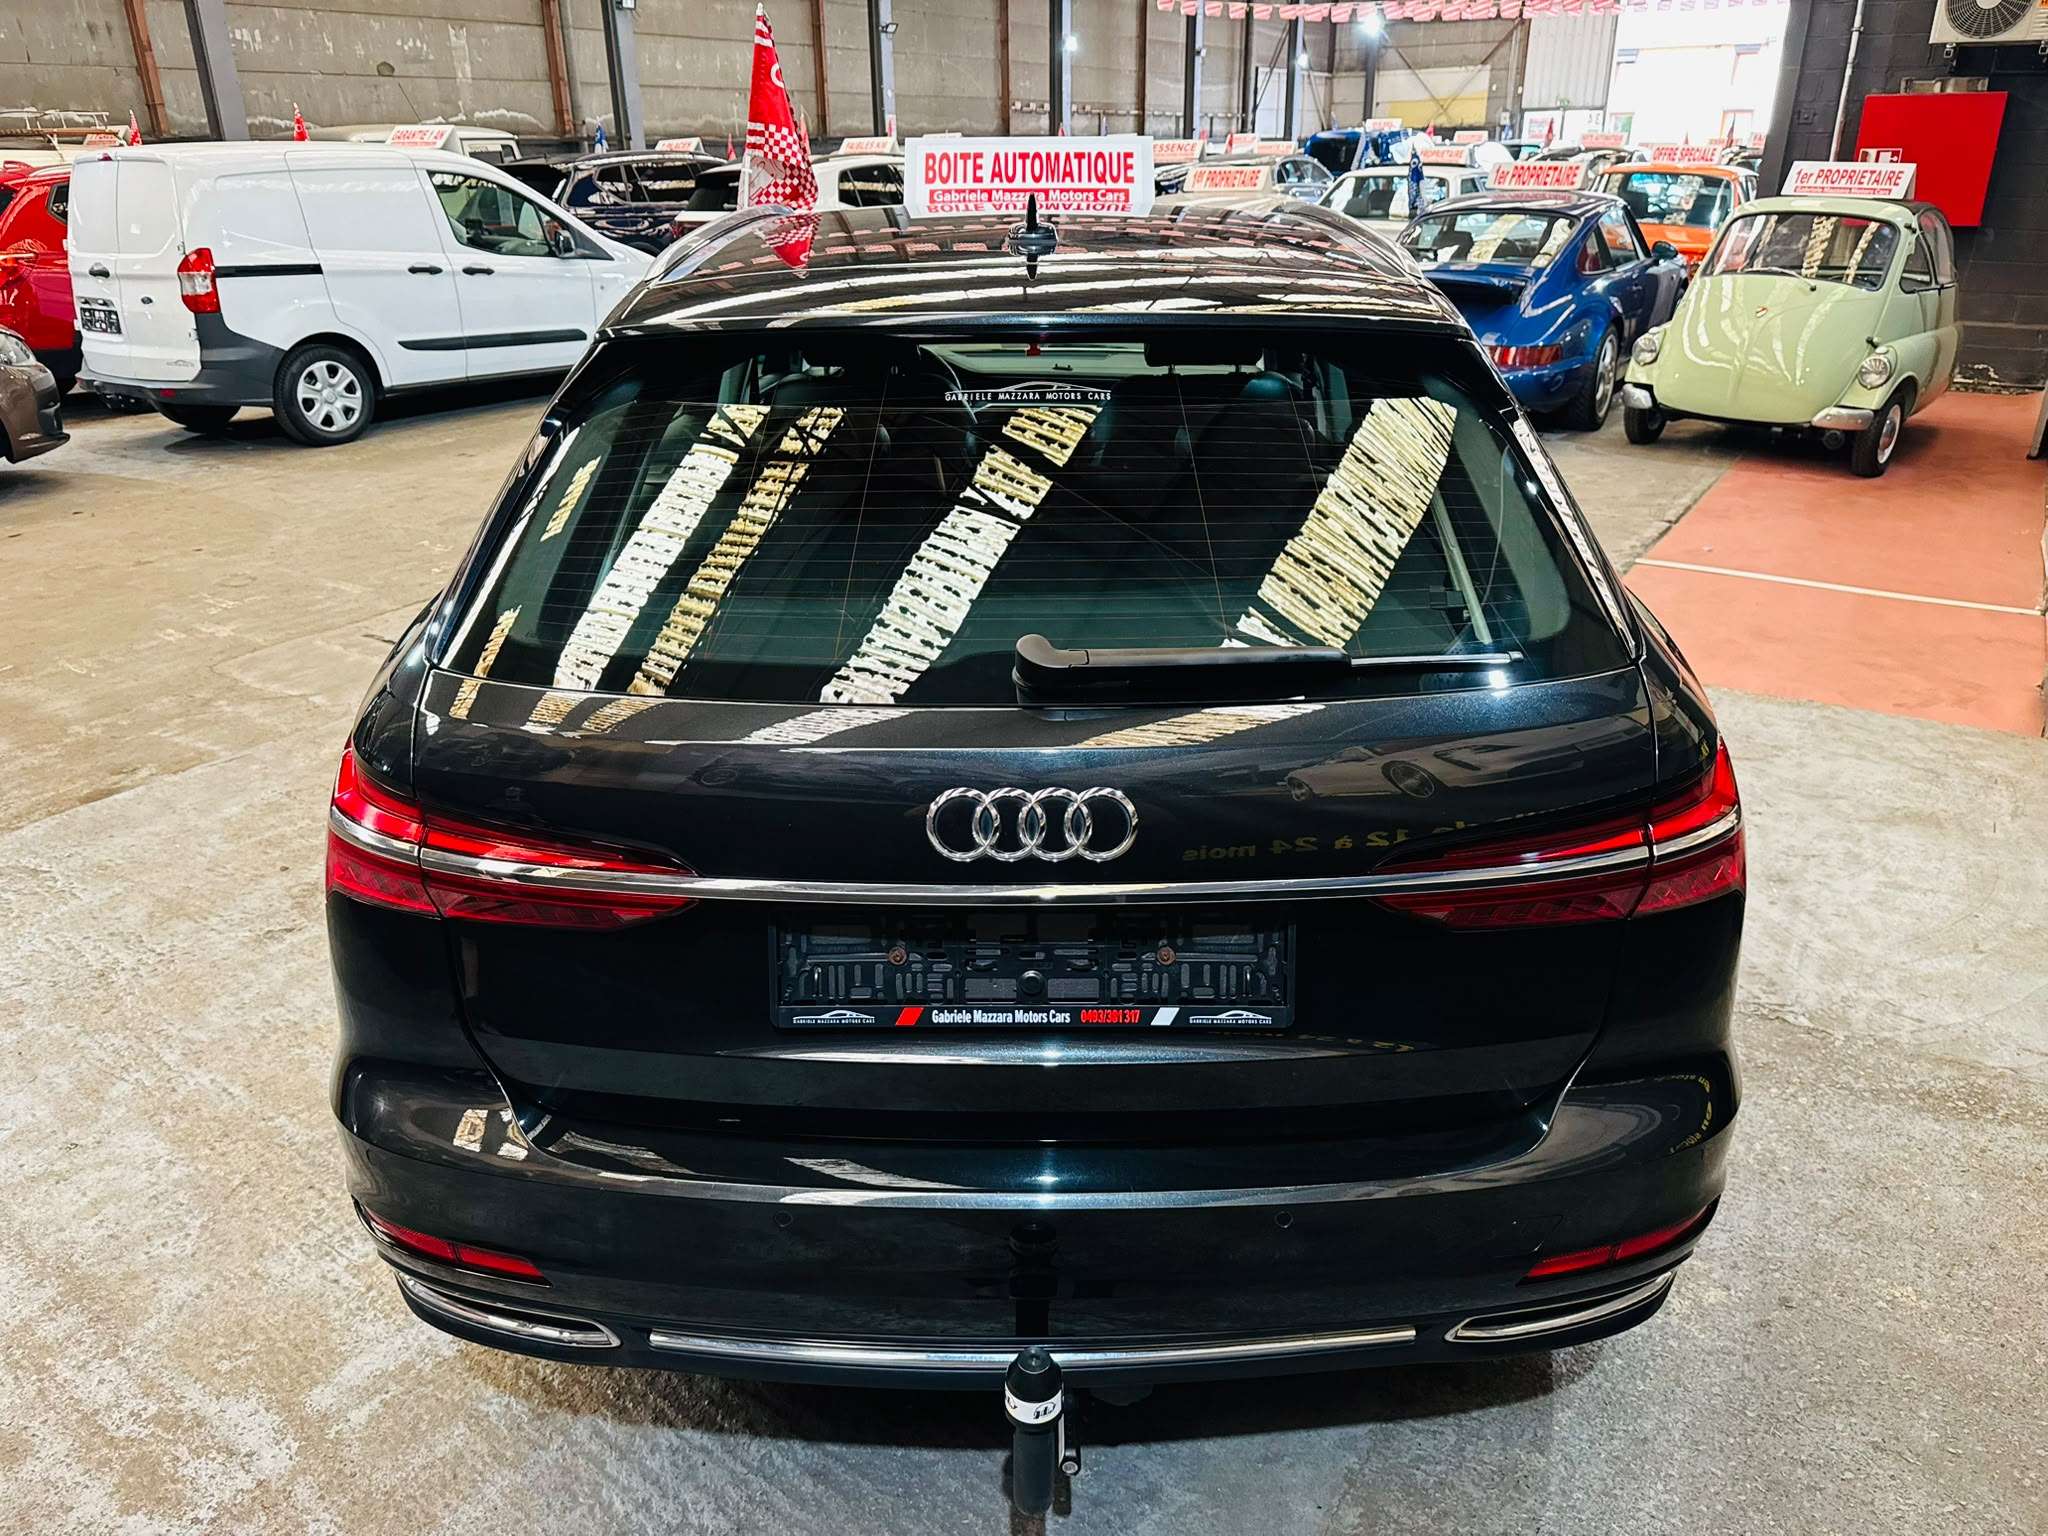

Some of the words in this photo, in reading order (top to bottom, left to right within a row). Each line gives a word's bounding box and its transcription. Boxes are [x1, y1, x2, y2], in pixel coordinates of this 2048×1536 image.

[1153, 143, 1197, 152] ESSENCE
[925, 152, 983, 184] BOITE
[990, 151, 1135, 185] AUTOMATIQUE
[1508, 165, 1580, 187] PROPRIETAIRE
[1204, 169, 1261, 188] PROPRIETAIRE
[1795, 168, 1814, 184] 1er
[1814, 169, 1904, 186] PROPRIETAIRE
[933, 190, 989, 202] Gabriele
[1049, 189, 1094, 201] Motors
[1097, 189, 1125, 201] Cars
[945, 393, 992, 401] GABRIELE
[998, 392, 1040, 401] MAZZARA
[1046, 392, 1081, 400] MOTORS
[1088, 392, 1111, 400] CARS
[932, 1009, 972, 1024] Gabriele
[973, 1010, 1013, 1024] Mazzara
[1014, 1010, 1048, 1024] Motors
[1049, 1009, 1071, 1024] Cars
